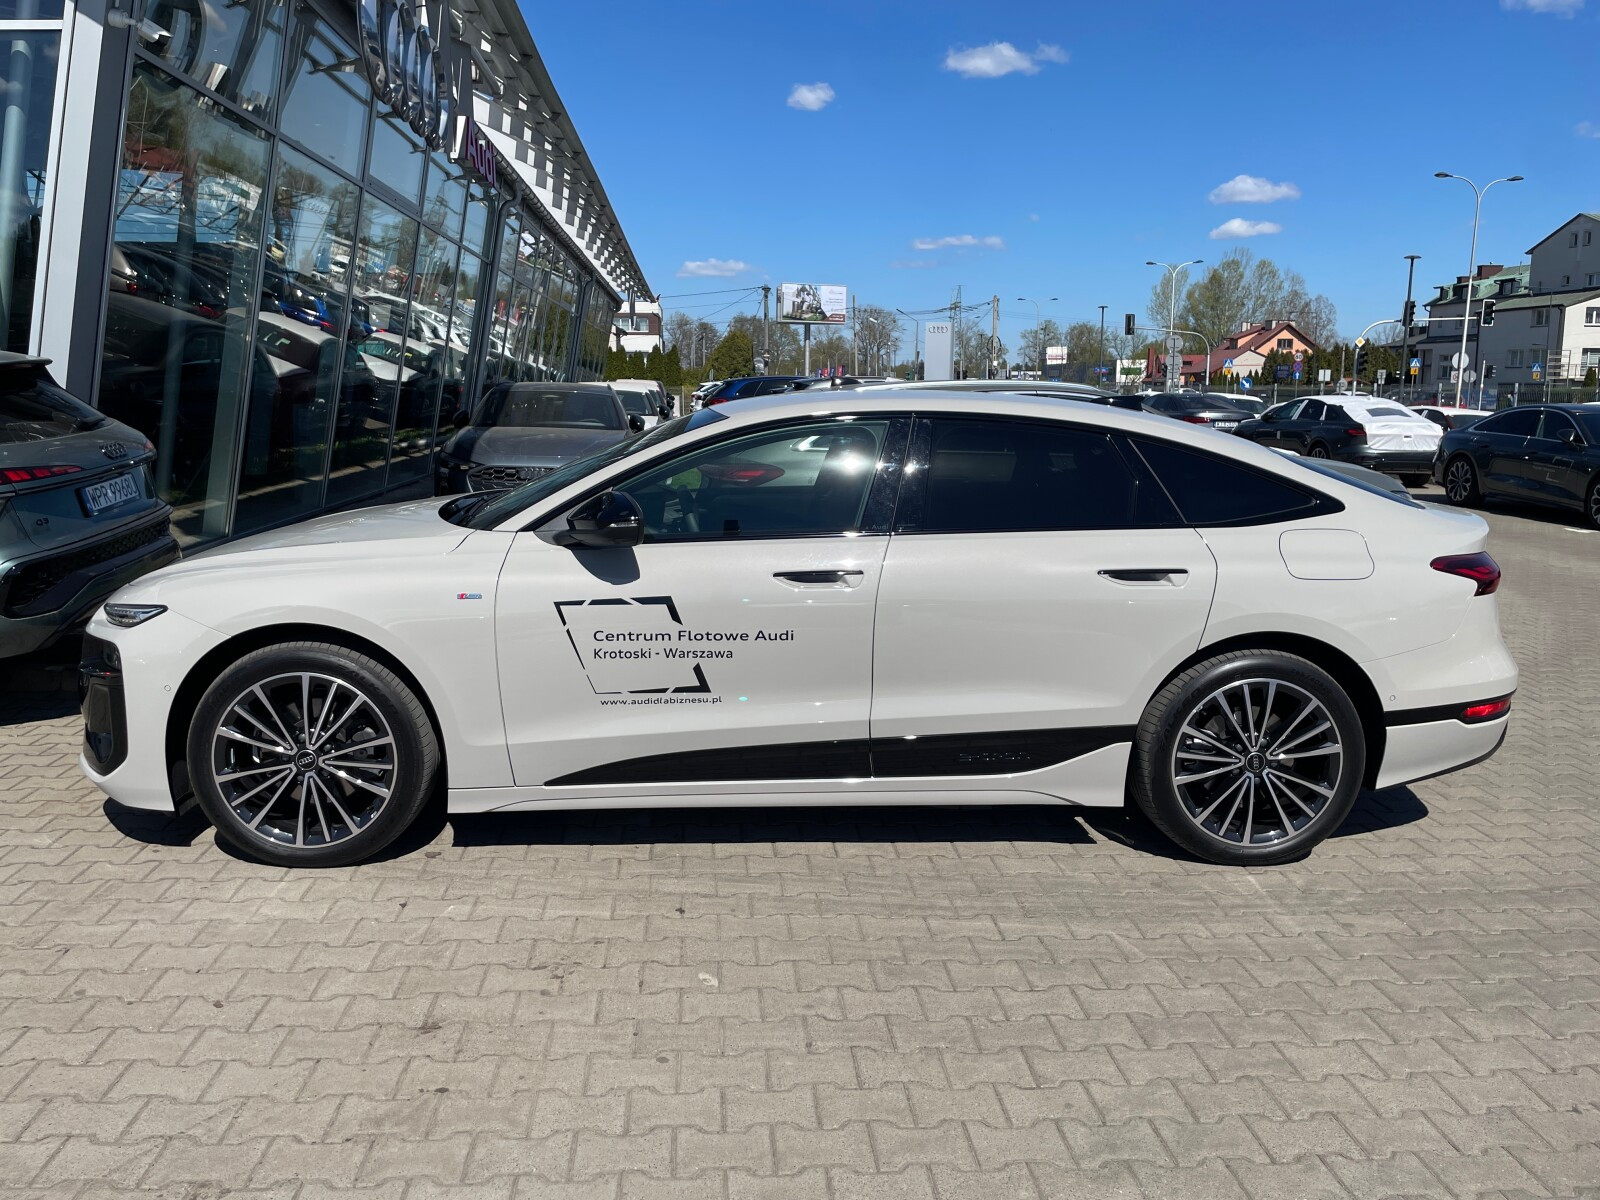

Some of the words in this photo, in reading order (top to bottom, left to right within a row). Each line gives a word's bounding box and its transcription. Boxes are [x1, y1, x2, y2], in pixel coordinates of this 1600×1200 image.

[466, 115, 497, 188] Audi
[88, 485, 111, 509] WPR
[109, 475, 138, 501] 9968U
[593, 630, 672, 642] Centrum
[677, 630, 750, 642] Flotowe
[754, 630, 794, 642] Audi
[593, 648, 652, 659] Krotoski
[663, 648, 733, 659] Warszawa
[600, 696, 723, 706] www.audidlabiznesu.pl
